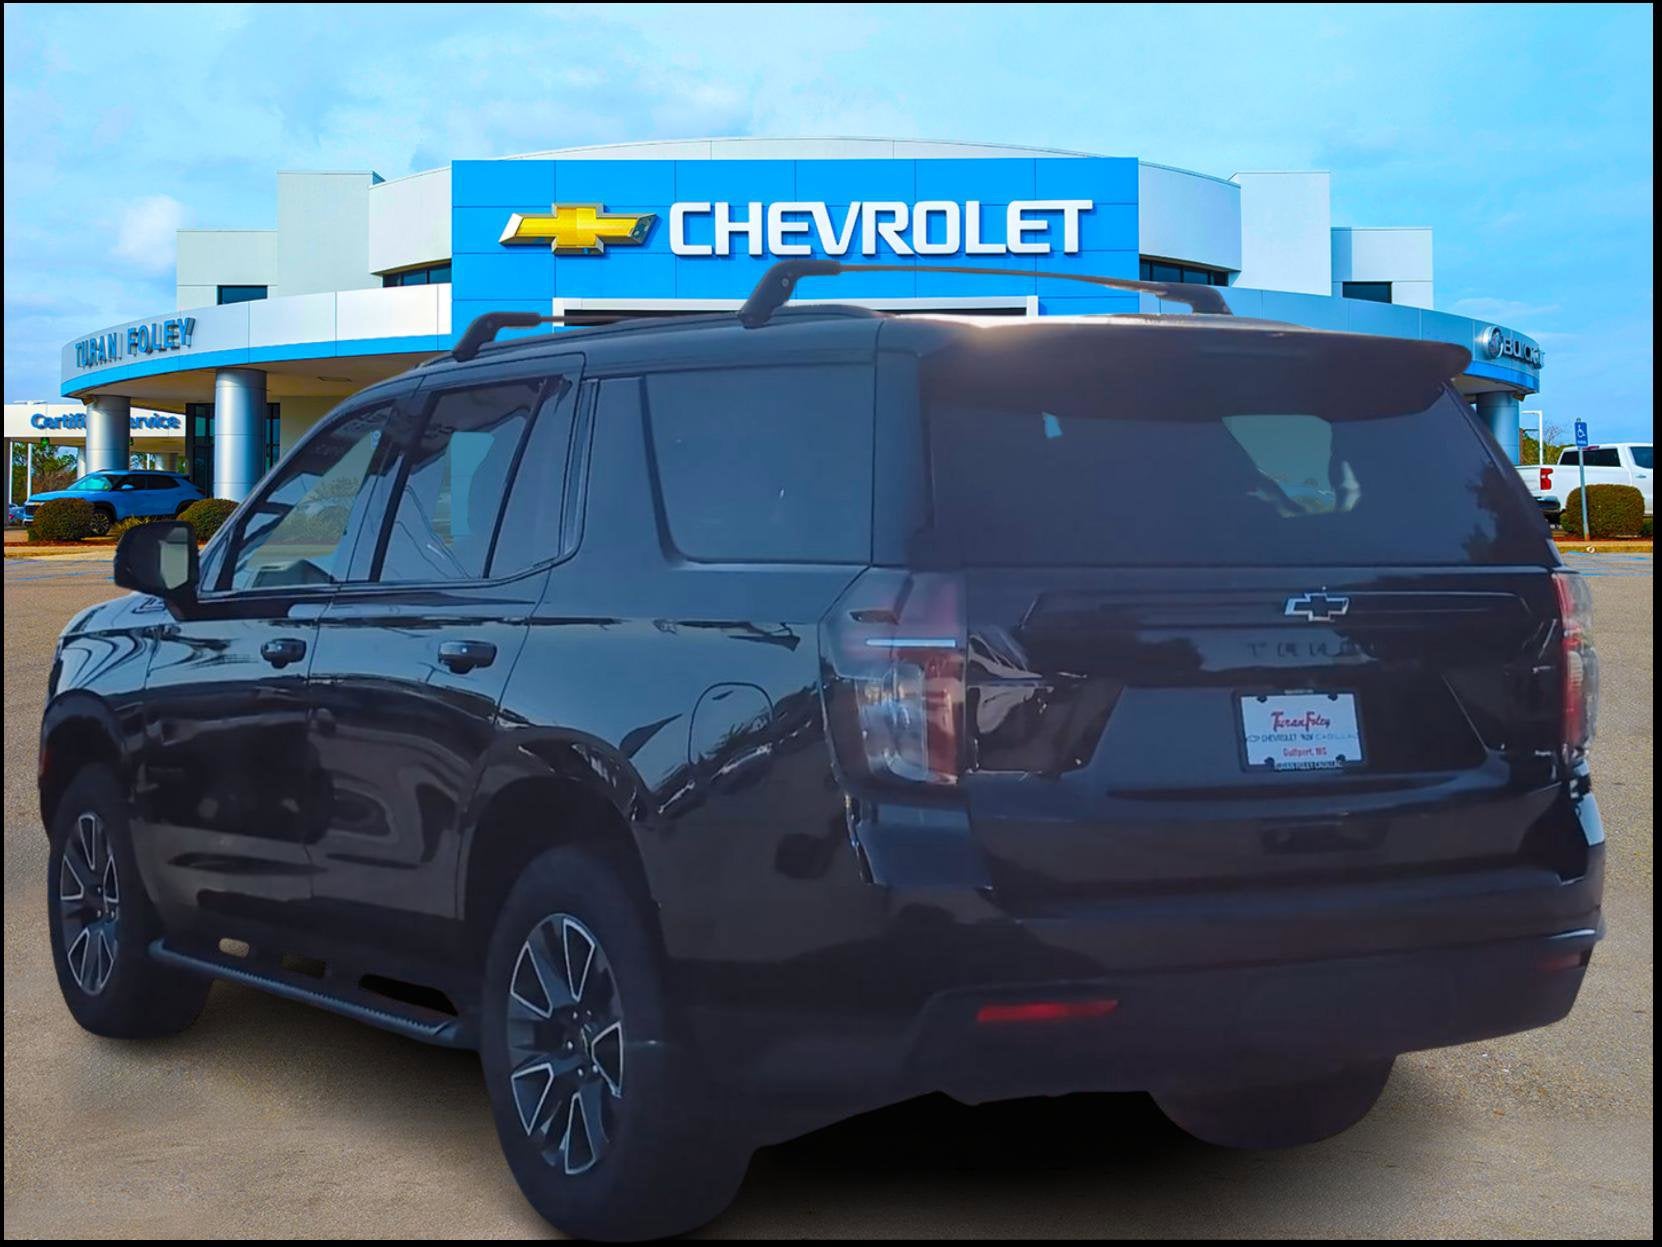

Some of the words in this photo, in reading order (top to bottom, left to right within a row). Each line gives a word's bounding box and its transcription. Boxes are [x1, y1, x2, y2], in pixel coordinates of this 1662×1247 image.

[669, 200, 1093, 256] CHEVROLET
[75, 332, 122, 369] TURAN
[127, 317, 196, 357] FOLEY
[30, 412, 87, 429] Certifi
[130, 412, 182, 429] ervice
